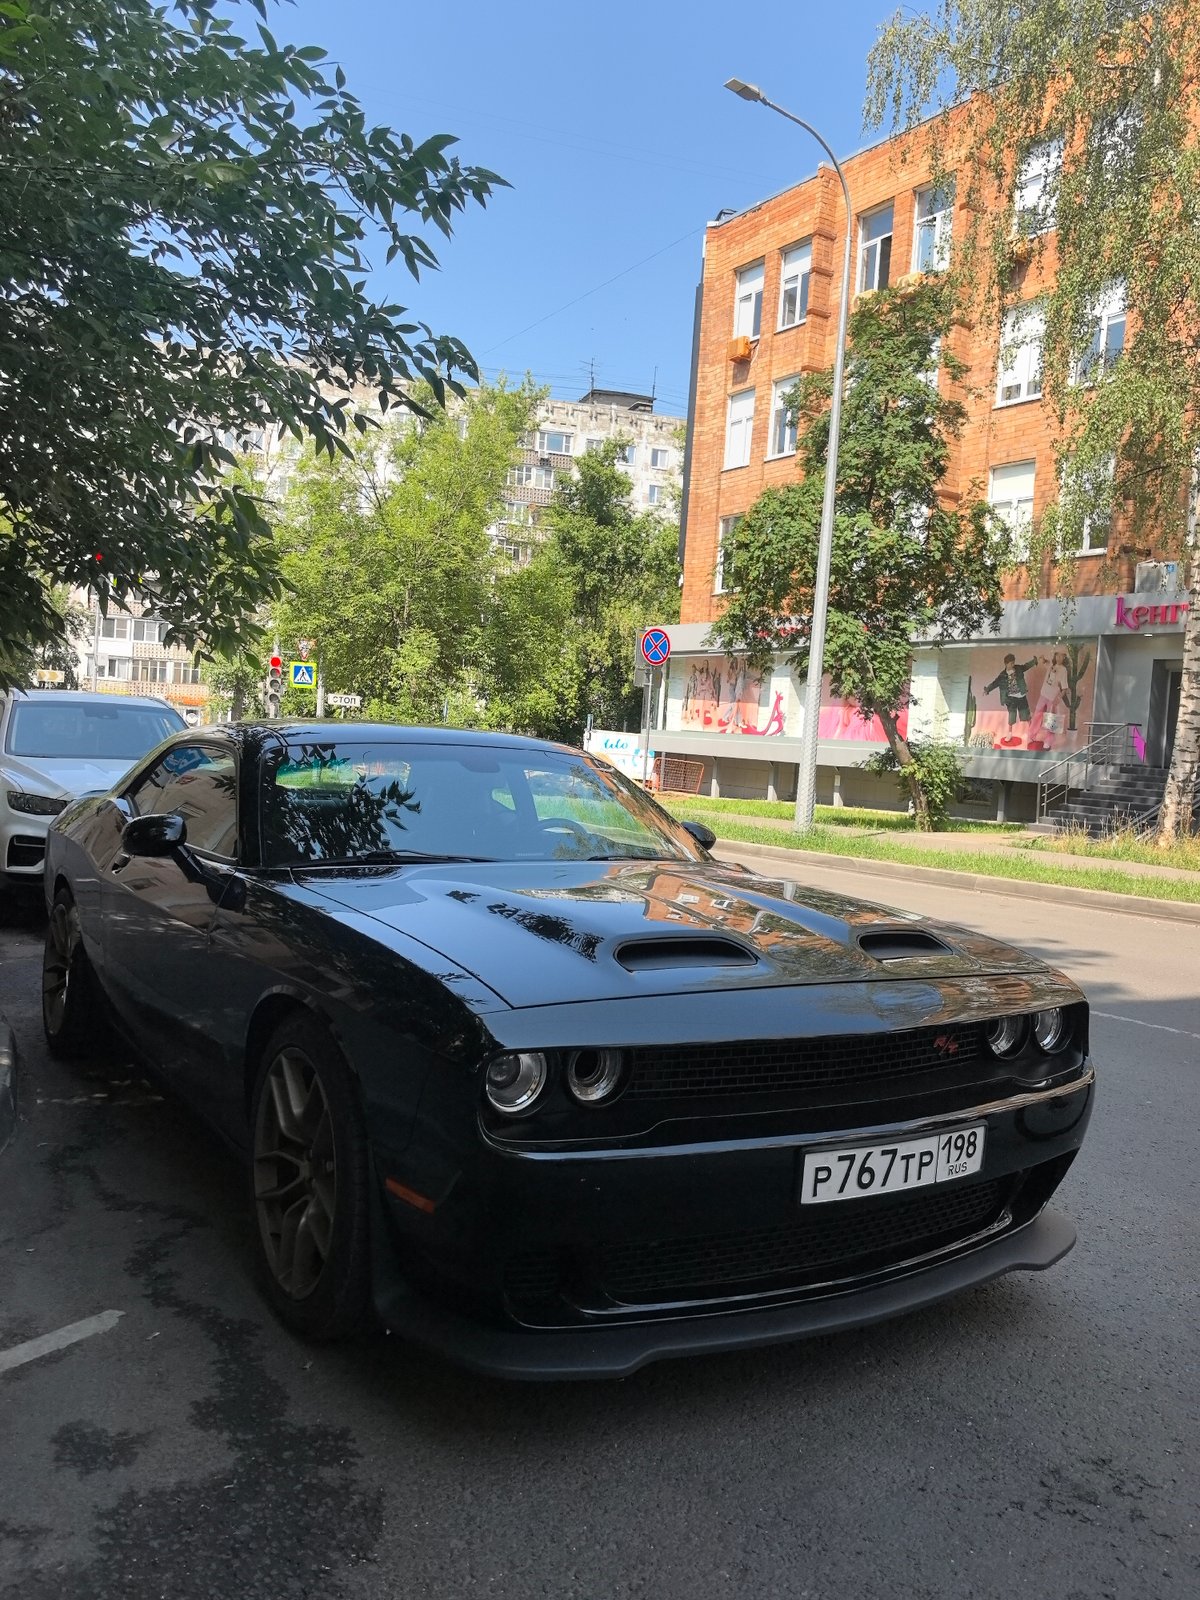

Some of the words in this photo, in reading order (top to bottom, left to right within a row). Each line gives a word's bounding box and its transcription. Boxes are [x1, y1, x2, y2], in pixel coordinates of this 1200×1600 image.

[1114, 597, 1188, 630] кенг
[812, 1148, 934, 1197] Р767ТР
[941, 1131, 977, 1163] 198
[948, 1161, 968, 1176] RUS
